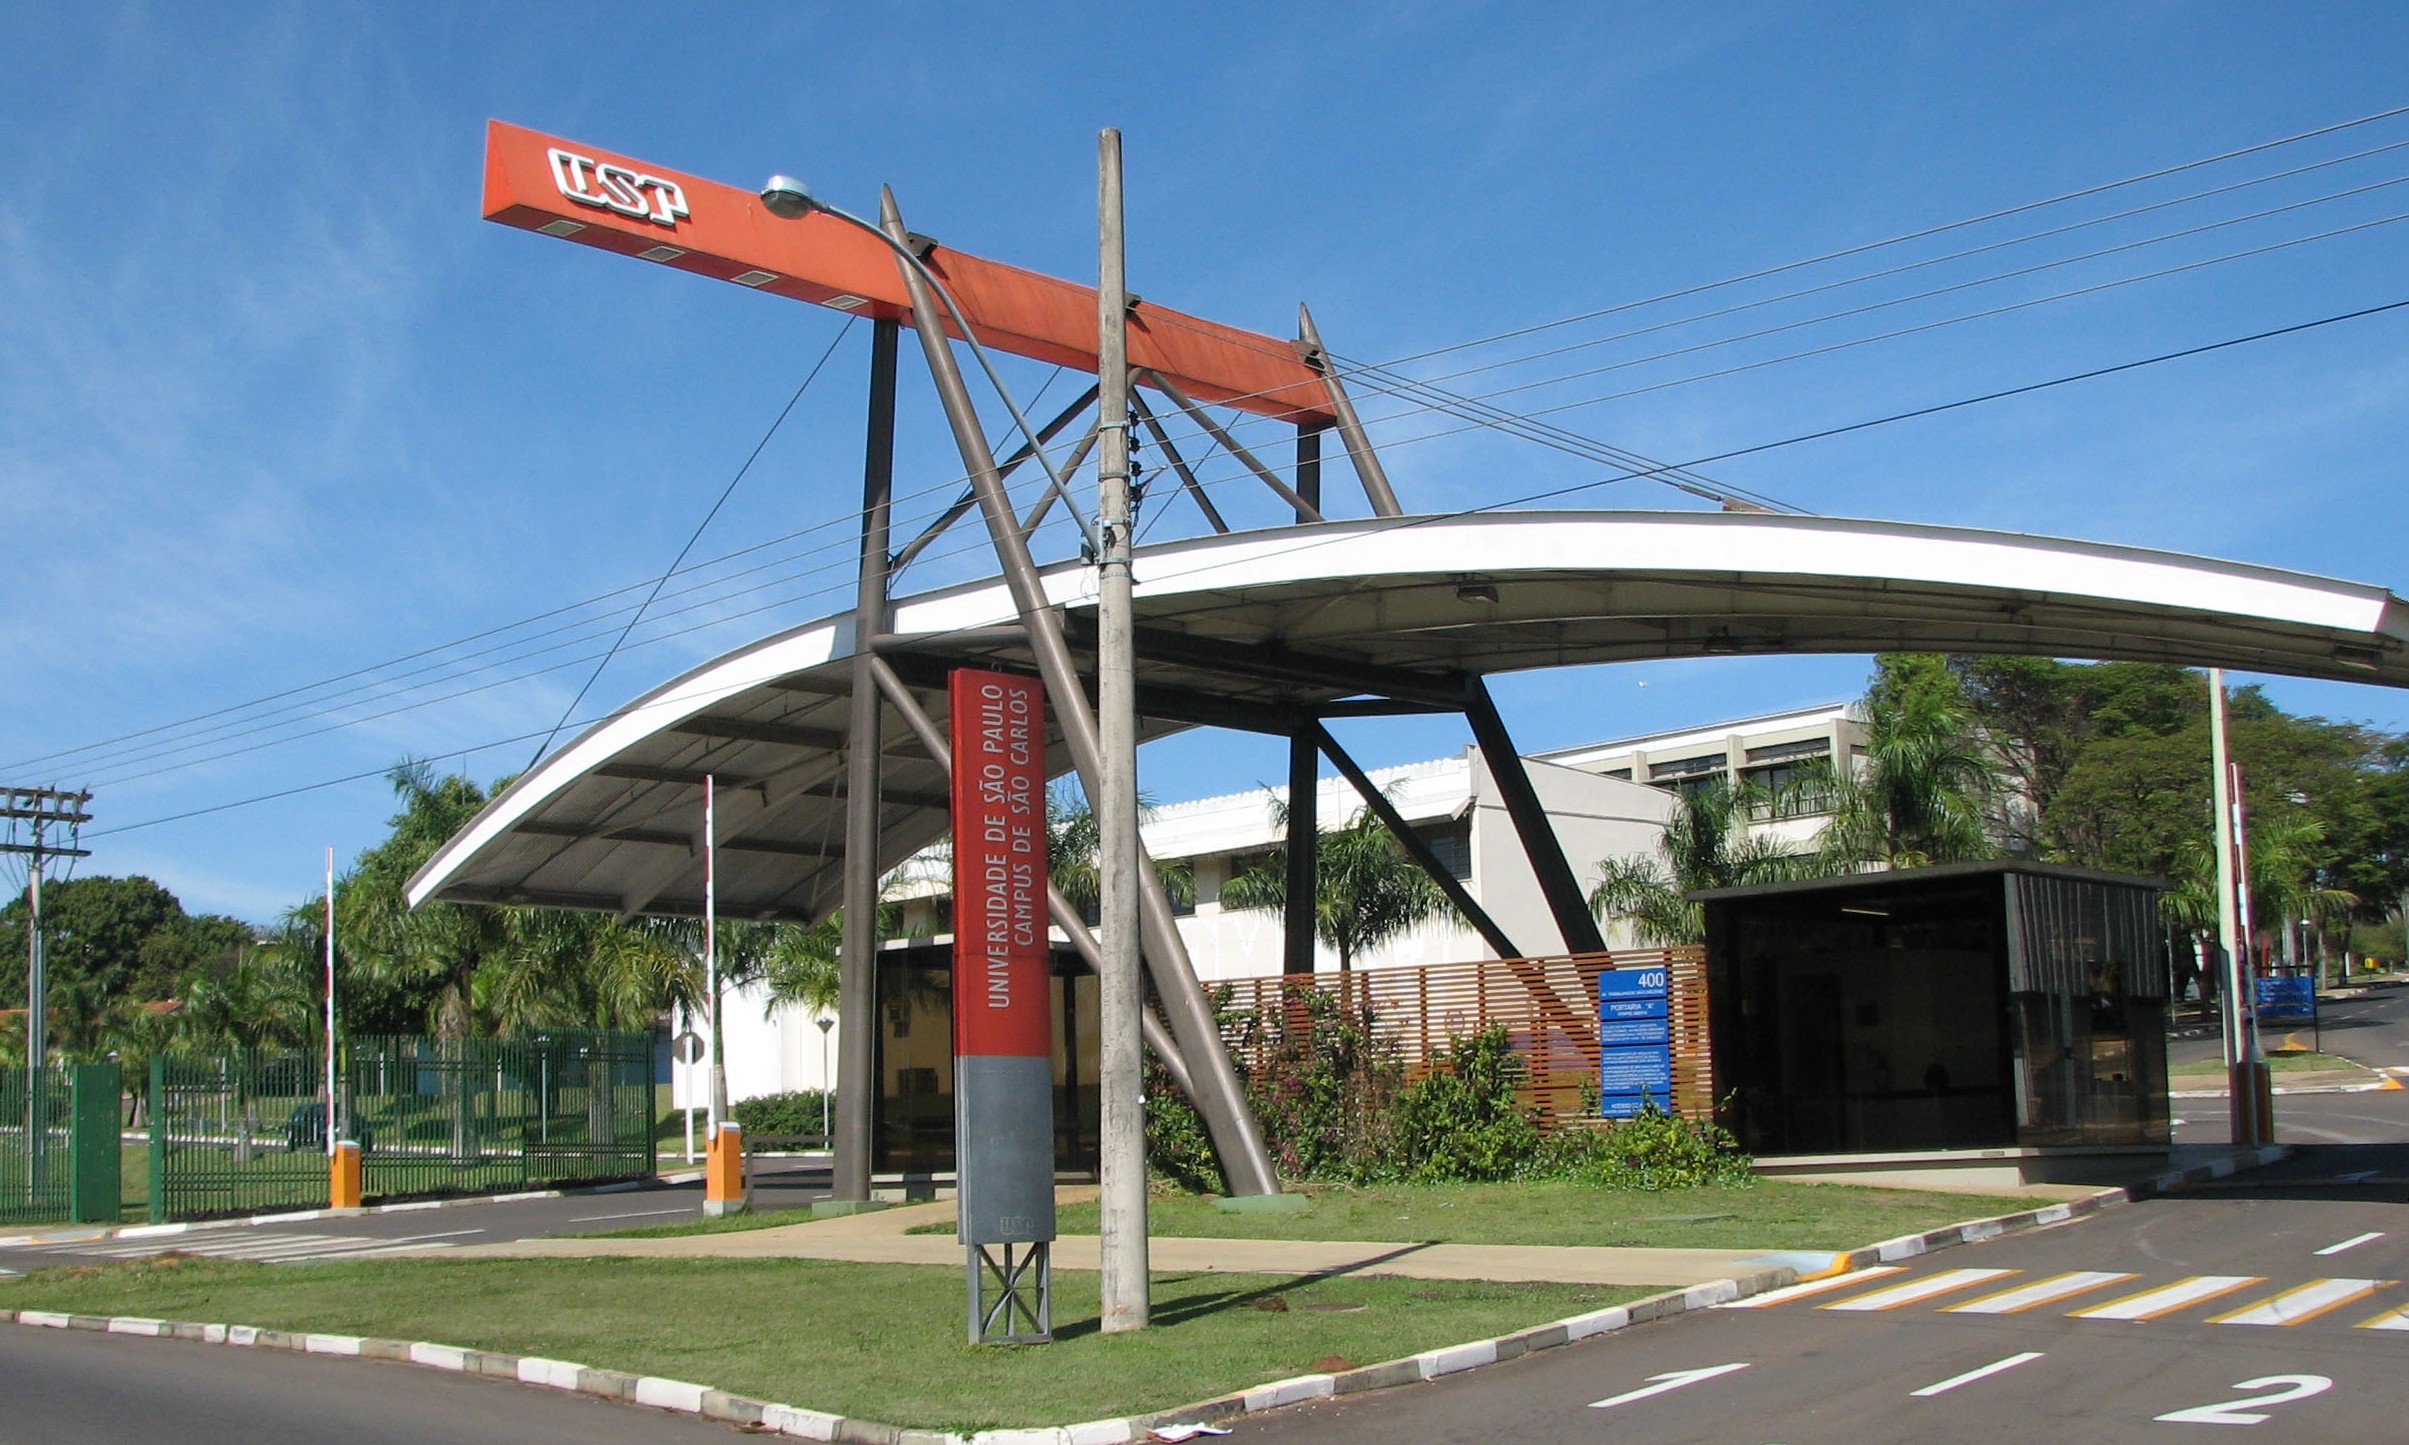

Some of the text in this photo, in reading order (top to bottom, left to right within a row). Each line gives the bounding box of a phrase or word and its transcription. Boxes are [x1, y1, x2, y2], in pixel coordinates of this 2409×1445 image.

[547, 148, 690, 226] USP
[979, 684, 1010, 1009] UNIVERSIDADE DE SÃO PAULO
[1006, 687, 1034, 946] CAMPUS DE SÃO CARLOS
[1638, 972, 1665, 988] 400
[2152, 1374, 2334, 1425] 2
